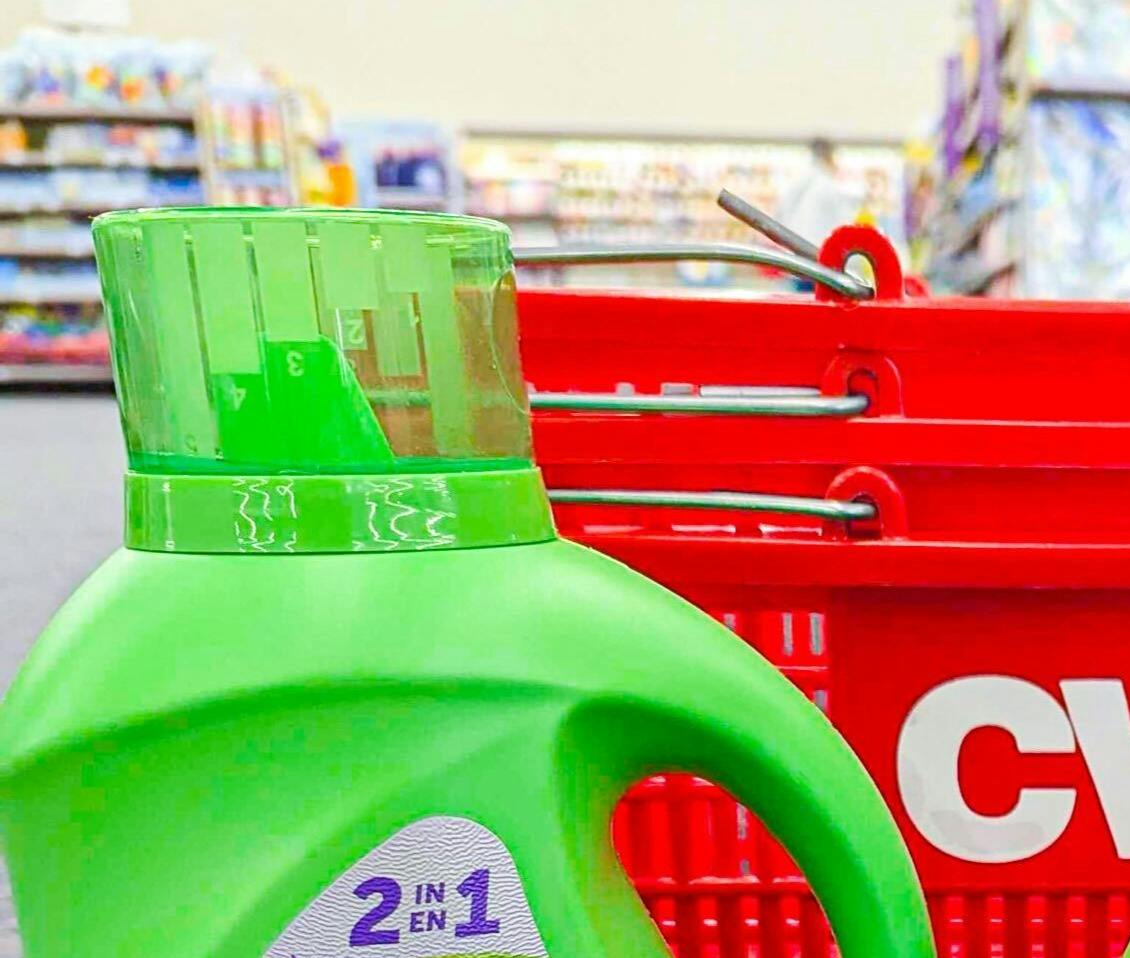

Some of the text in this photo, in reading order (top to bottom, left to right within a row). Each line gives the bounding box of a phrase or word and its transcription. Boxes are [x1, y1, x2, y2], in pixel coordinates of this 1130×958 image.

[349, 868, 501, 948] 2 IN 1
[409, 910, 447, 934] EN
